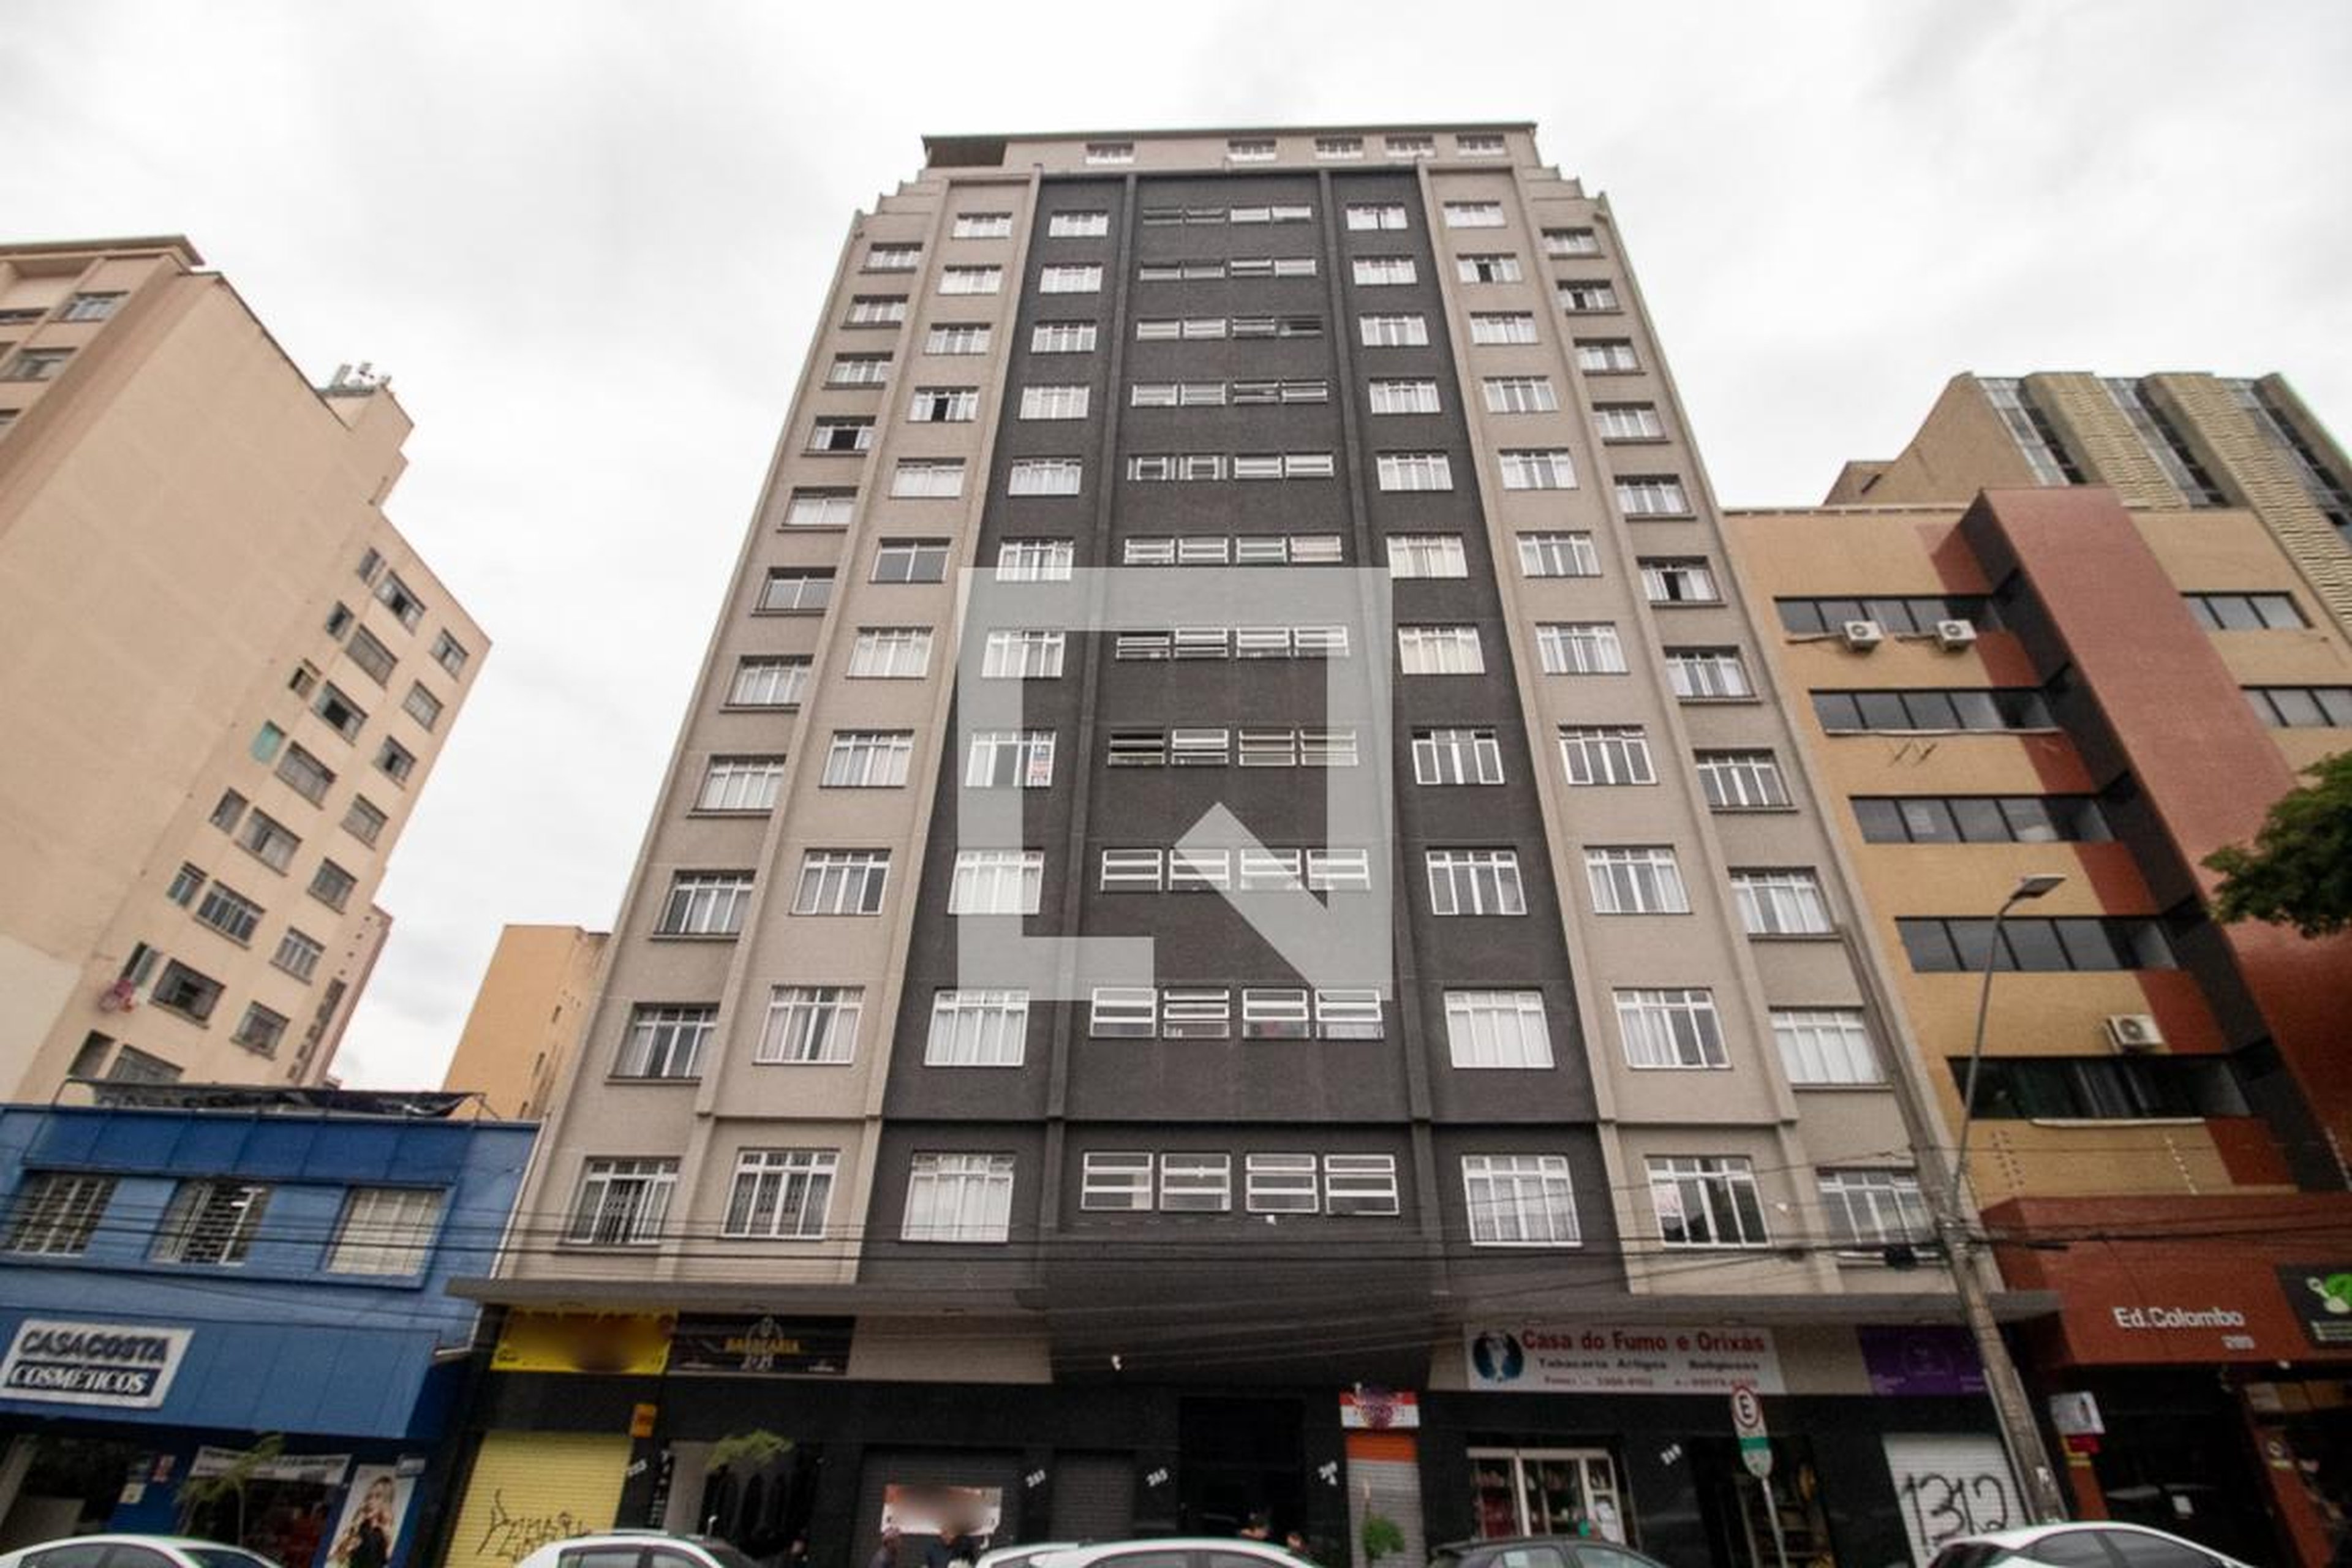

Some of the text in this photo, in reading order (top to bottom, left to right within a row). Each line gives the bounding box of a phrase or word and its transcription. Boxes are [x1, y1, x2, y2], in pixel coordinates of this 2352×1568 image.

[1522, 1329, 1572, 1350] Casa
[1581, 1330, 1605, 1351] do
[1612, 1330, 1667, 1352] Fumo
[1676, 1336, 1690, 1351] e
[1738, 1394, 1753, 1419] E
